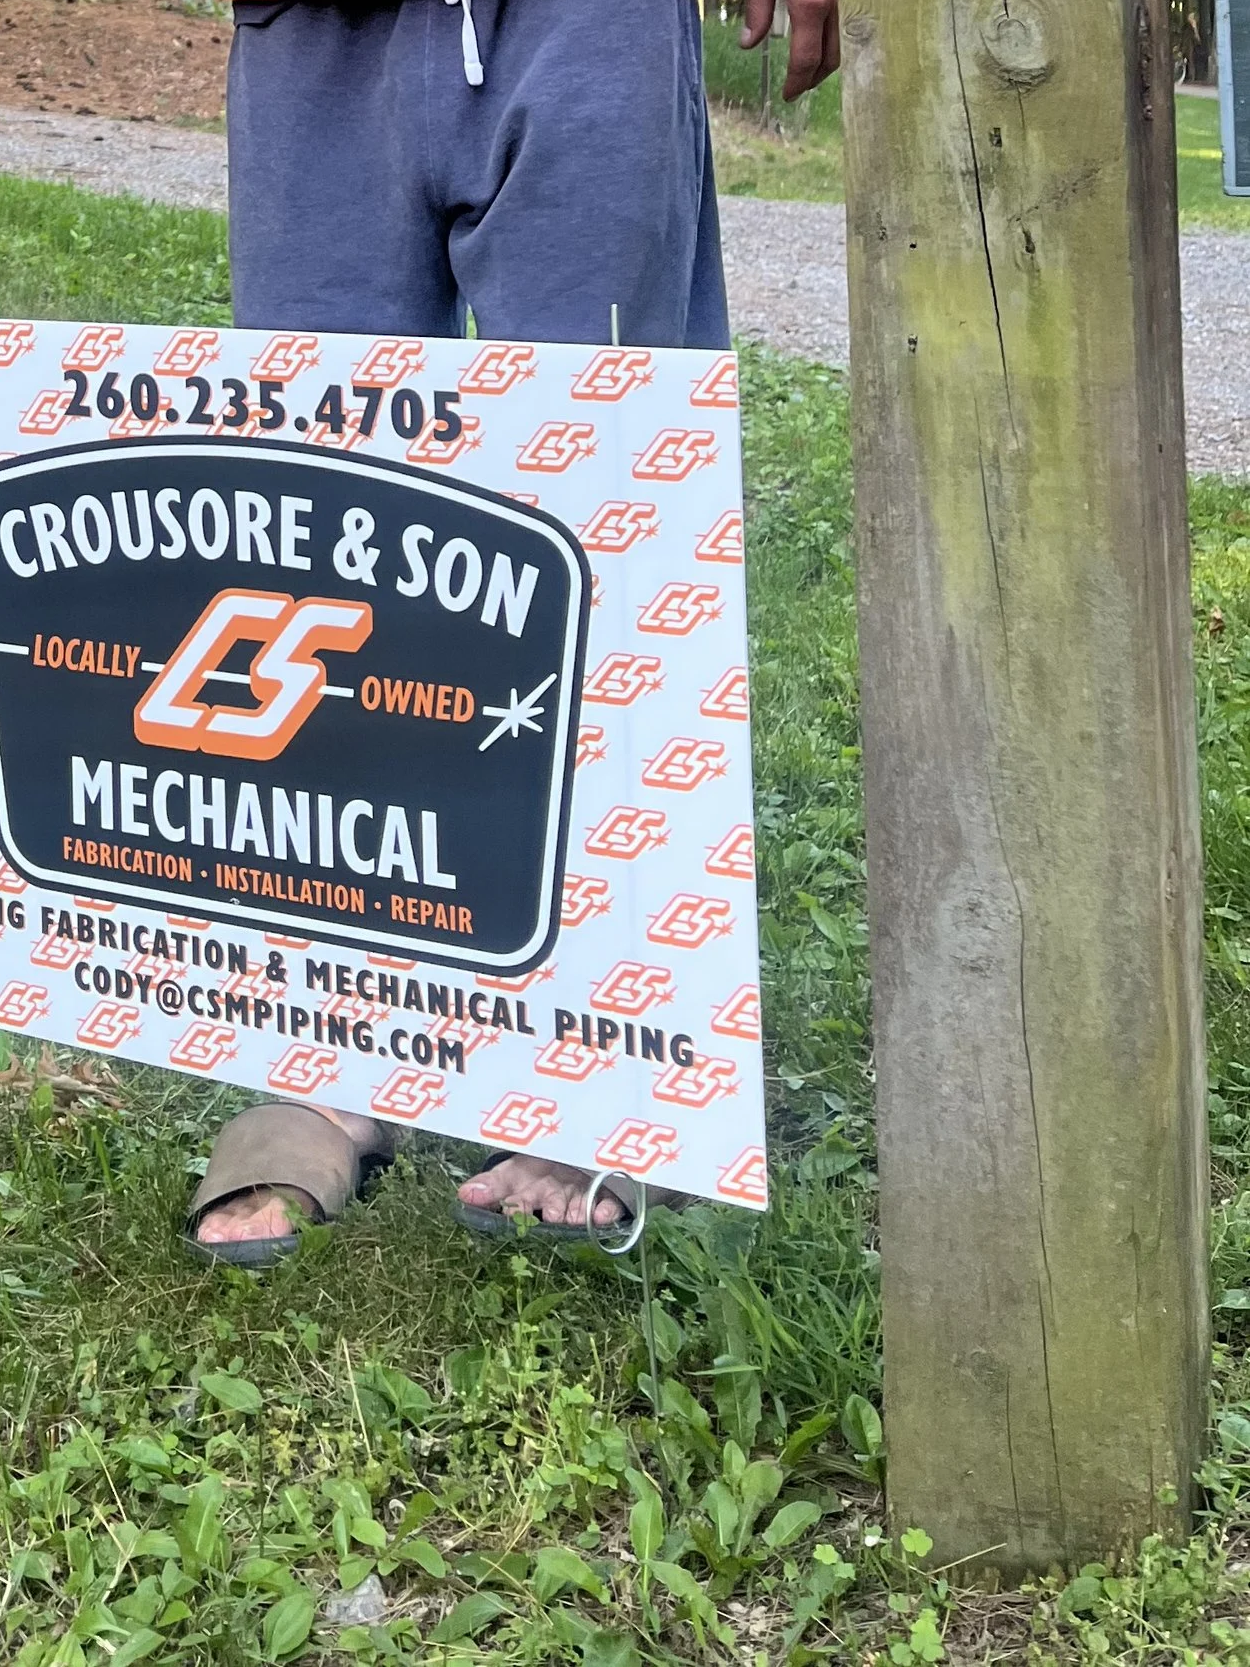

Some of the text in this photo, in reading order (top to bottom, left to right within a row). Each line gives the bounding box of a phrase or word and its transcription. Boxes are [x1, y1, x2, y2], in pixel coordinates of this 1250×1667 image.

[64, 370, 463, 441] 260.235.4705
[0, 488, 313, 578] CROUSORE
[333, 507, 379, 586] &
[396, 524, 540, 638] SON
[33, 634, 475, 723] LOCALLY OWNED
[71, 755, 457, 890] MECHANICAL
[63, 836, 192, 882] FABRICATION
[216, 864, 365, 914] INSTALLATION
[391, 895, 473, 934] REPAIR
[41, 907, 248, 976] FABRICATION
[266, 950, 287, 983] &
[306, 958, 535, 1035] MECHANICAL
[554, 1008, 694, 1068] PIPING
[74, 961, 466, 1074] CODY@CSMPIPING.COM
